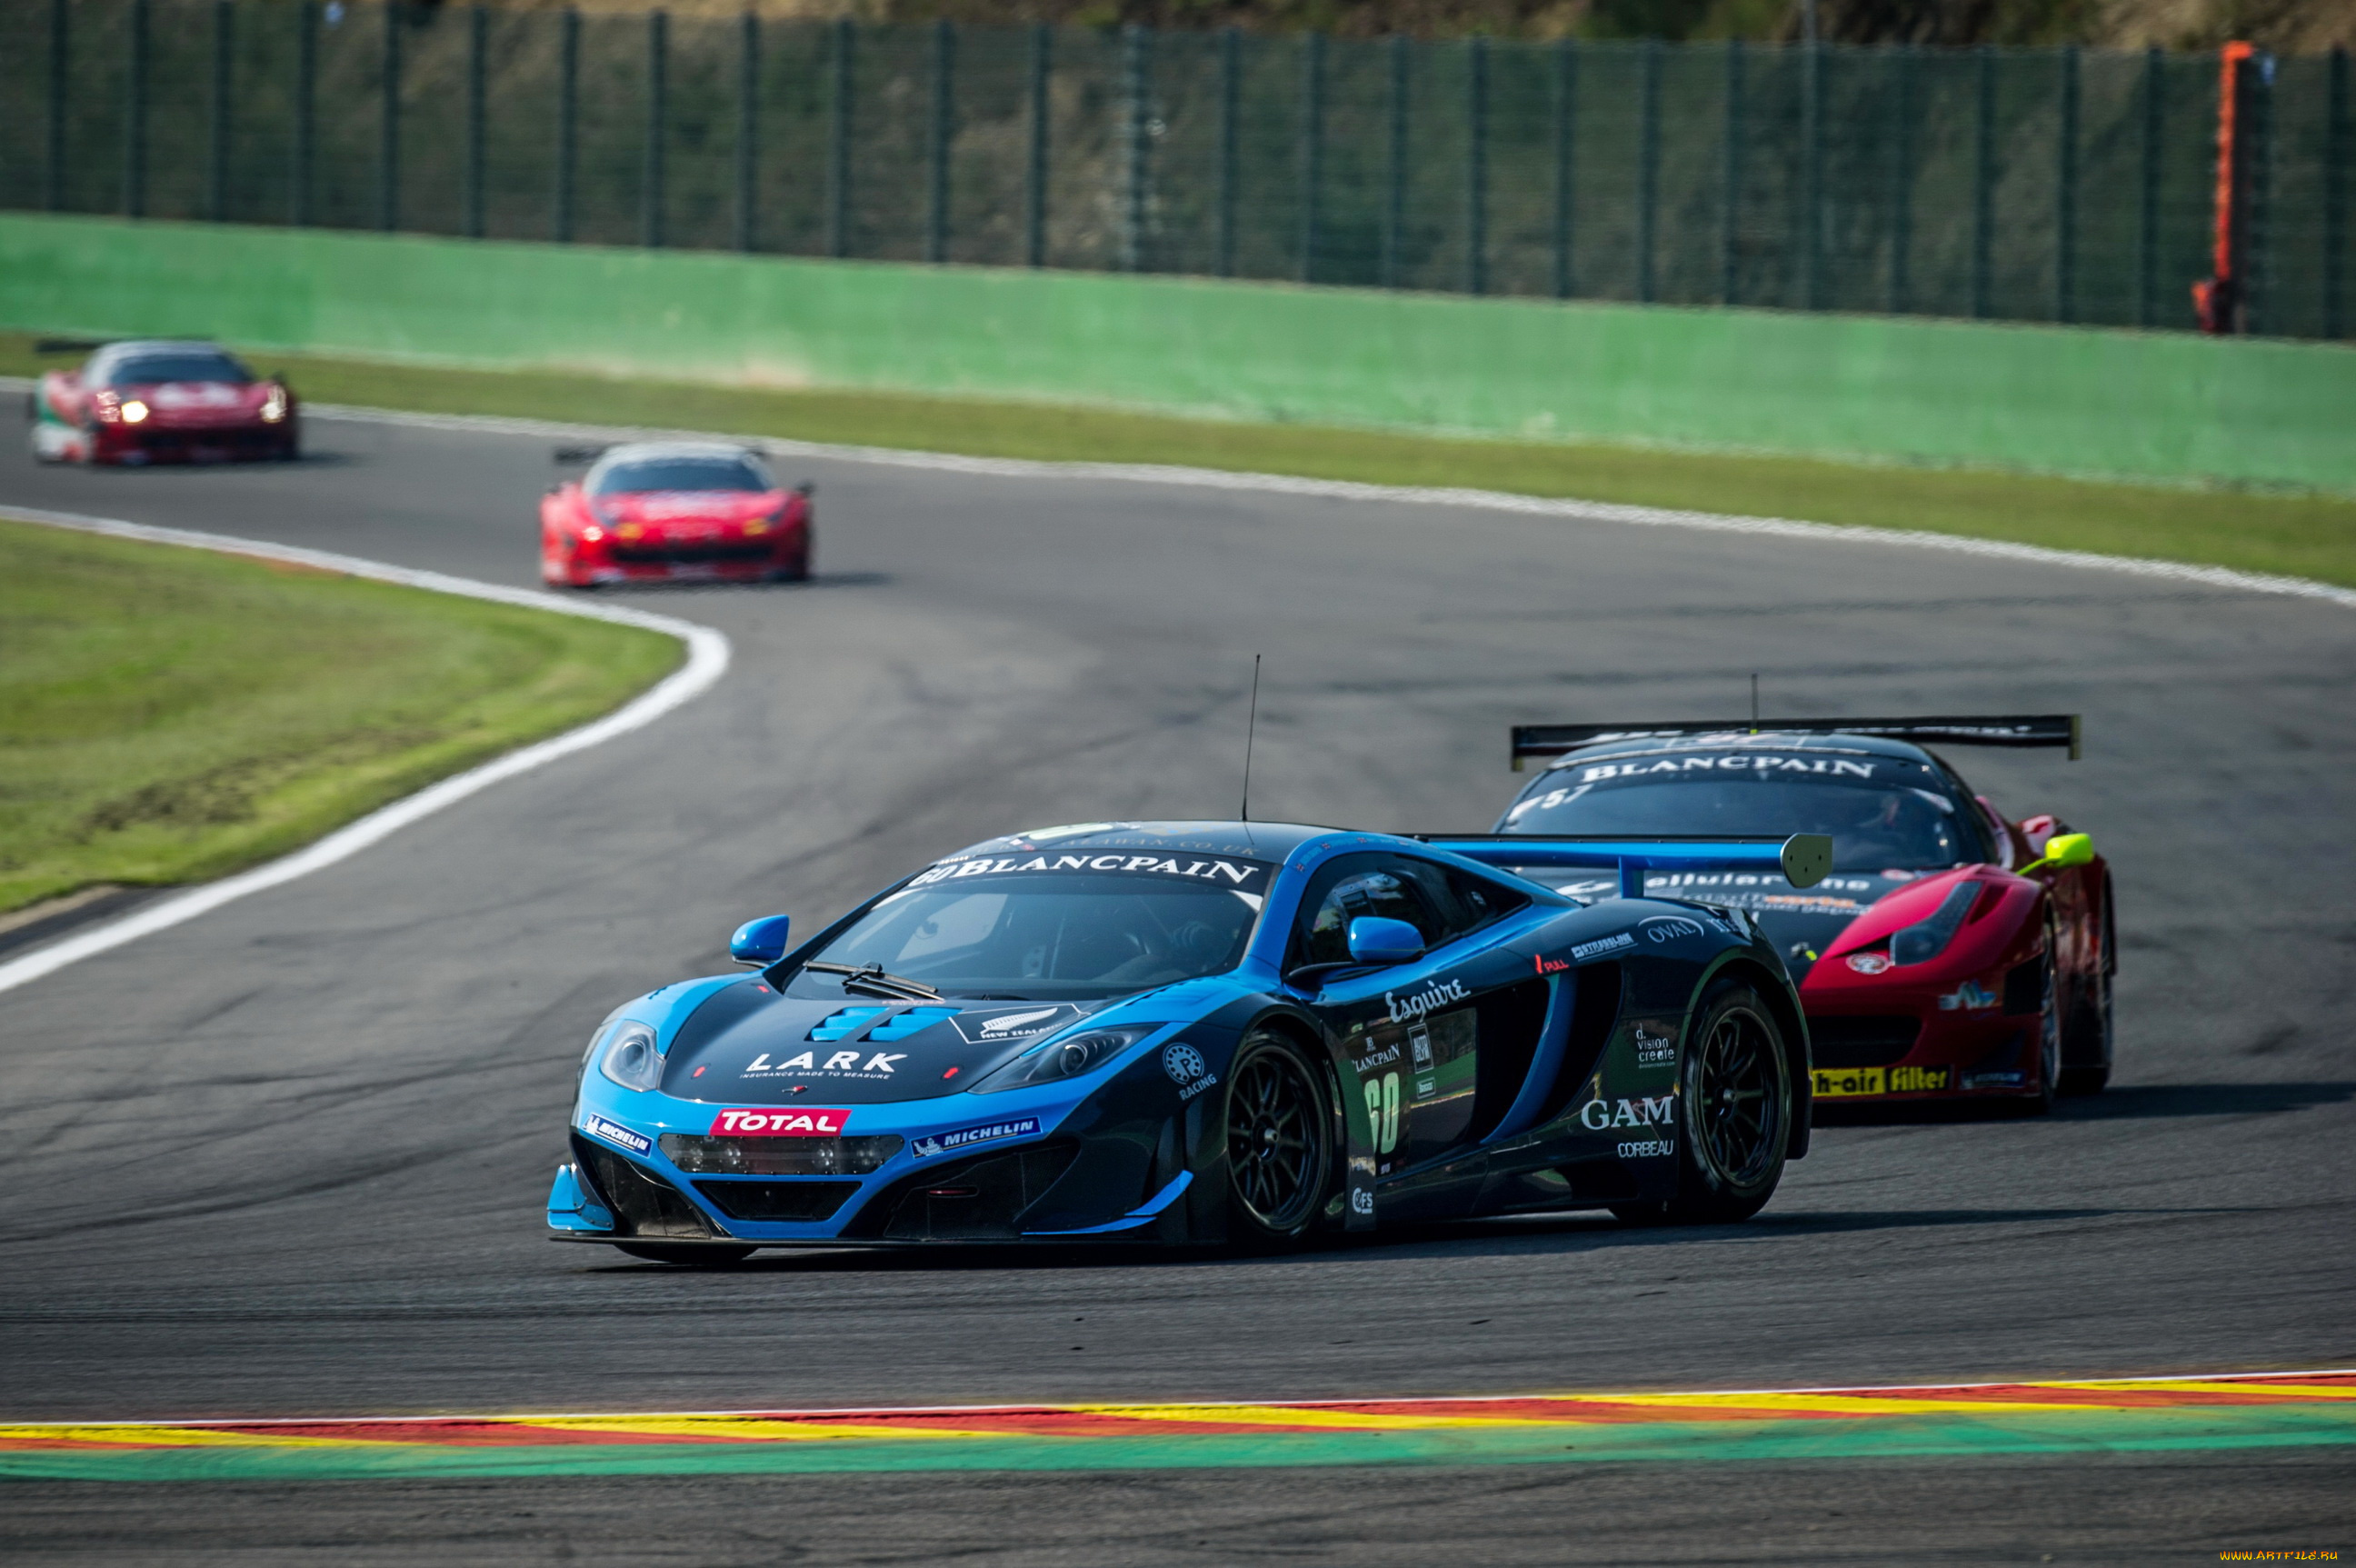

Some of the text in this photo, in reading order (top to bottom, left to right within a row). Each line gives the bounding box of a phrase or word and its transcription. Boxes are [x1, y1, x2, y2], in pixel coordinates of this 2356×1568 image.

[1582, 754, 1877, 784] BLANCPAIN
[908, 864, 957, 887] 60
[949, 854, 1259, 884] BLANCPAIN
[1647, 921, 1696, 943] OVAL
[1543, 959, 1570, 973] PULL
[1385, 979, 1471, 1024] Esquire
[1637, 1038, 1669, 1050] vision
[1639, 1048, 1674, 1062] create
[745, 1051, 908, 1073] LARK
[1353, 1044, 1401, 1073] LANCPAIN
[739, 1071, 794, 1079] INSURANCE
[844, 1072, 890, 1080] MEASURE
[1179, 1074, 1217, 1101] RACING
[1815, 1073, 1880, 1093] h-air
[1890, 1066, 1948, 1091] filter
[722, 1111, 840, 1132] TOTAL
[1581, 1095, 1673, 1130] GAM
[598, 1121, 649, 1151] MICHELIN
[944, 1121, 1033, 1146] MICHELIN
[1618, 1140, 1673, 1158] CORBEAU
